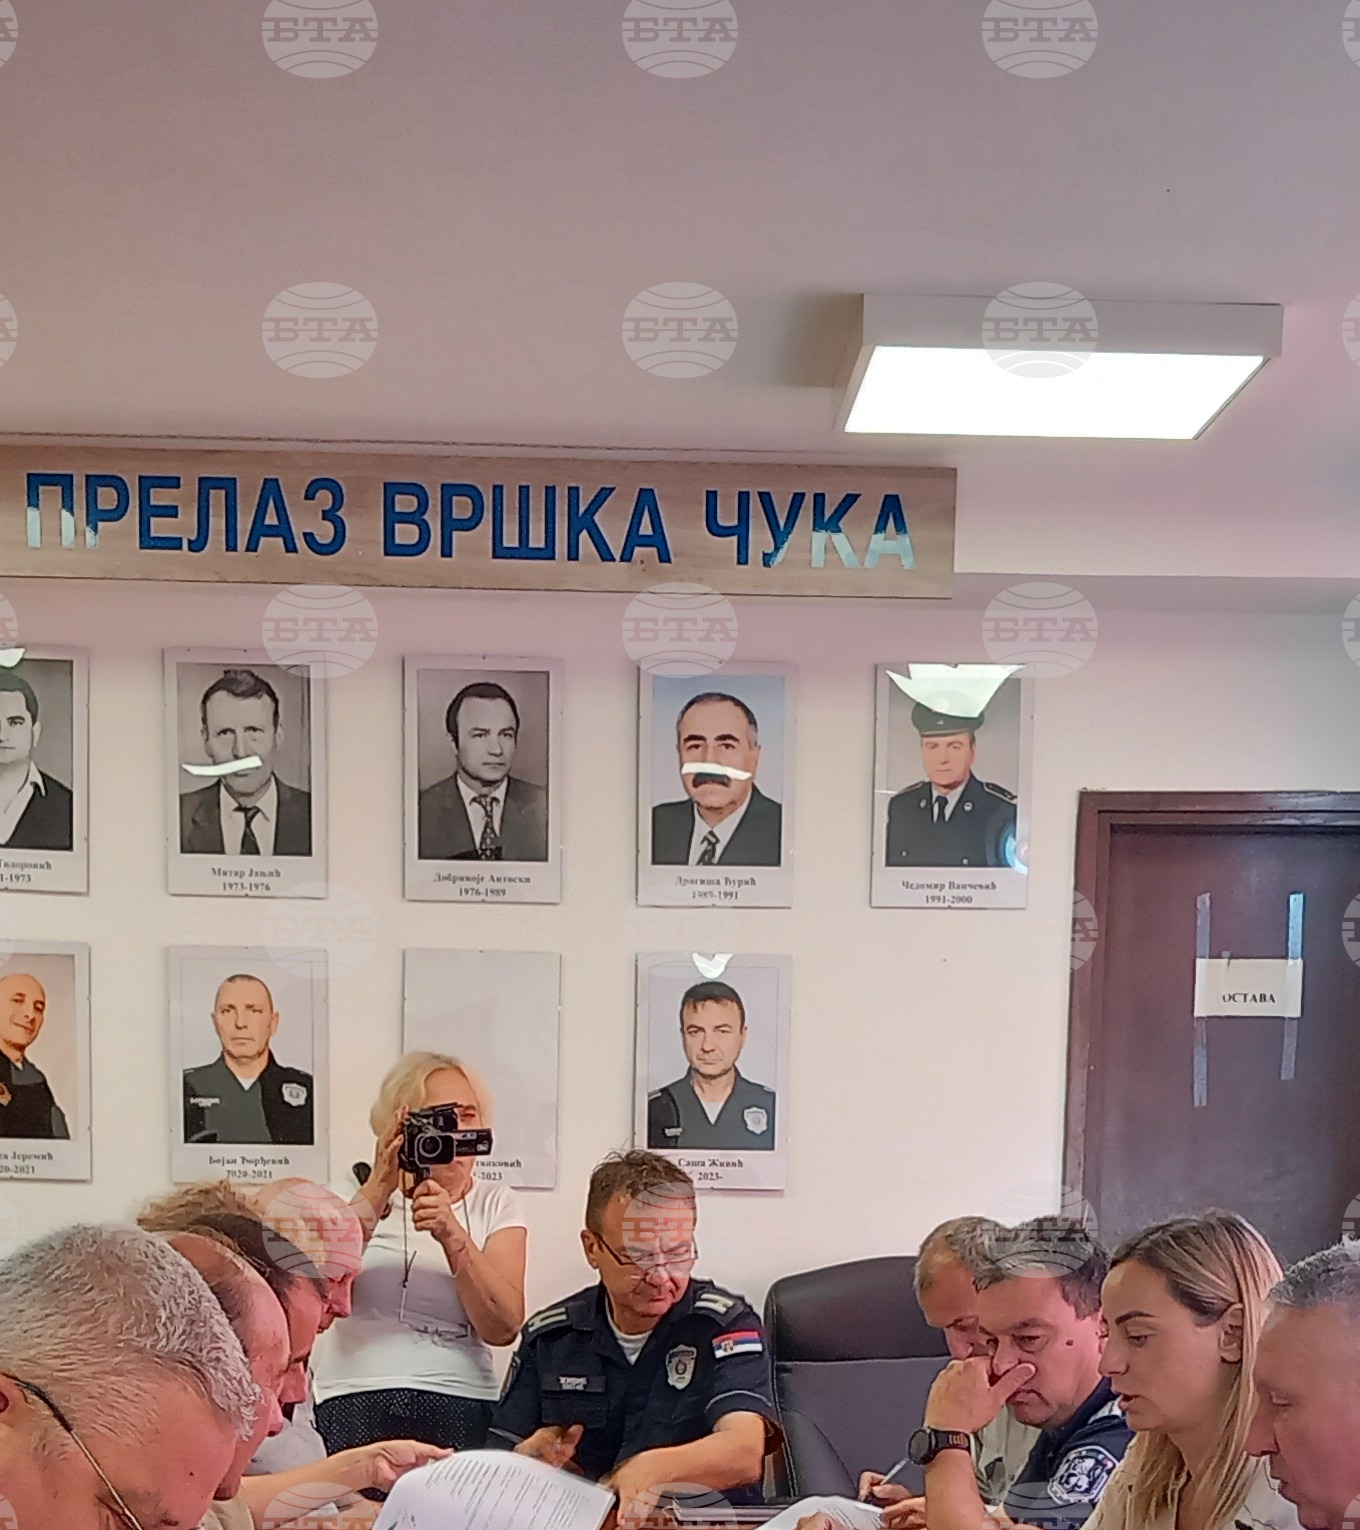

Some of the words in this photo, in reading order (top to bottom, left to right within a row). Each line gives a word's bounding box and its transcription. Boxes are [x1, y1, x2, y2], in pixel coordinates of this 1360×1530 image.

[26, 472, 348, 556] ПРЕЛАЗ
[382, 481, 673, 564] ВРШКА
[706, 489, 916, 570] ЧУКА
[222, 882, 271, 891] 1973-1976
[459, 887, 507, 897] 1976-1989
[925, 895, 973, 904] 1991-2000
[1222, 992, 1276, 1005] ОСТАВА
[678, 1158, 706, 1167] Саша
